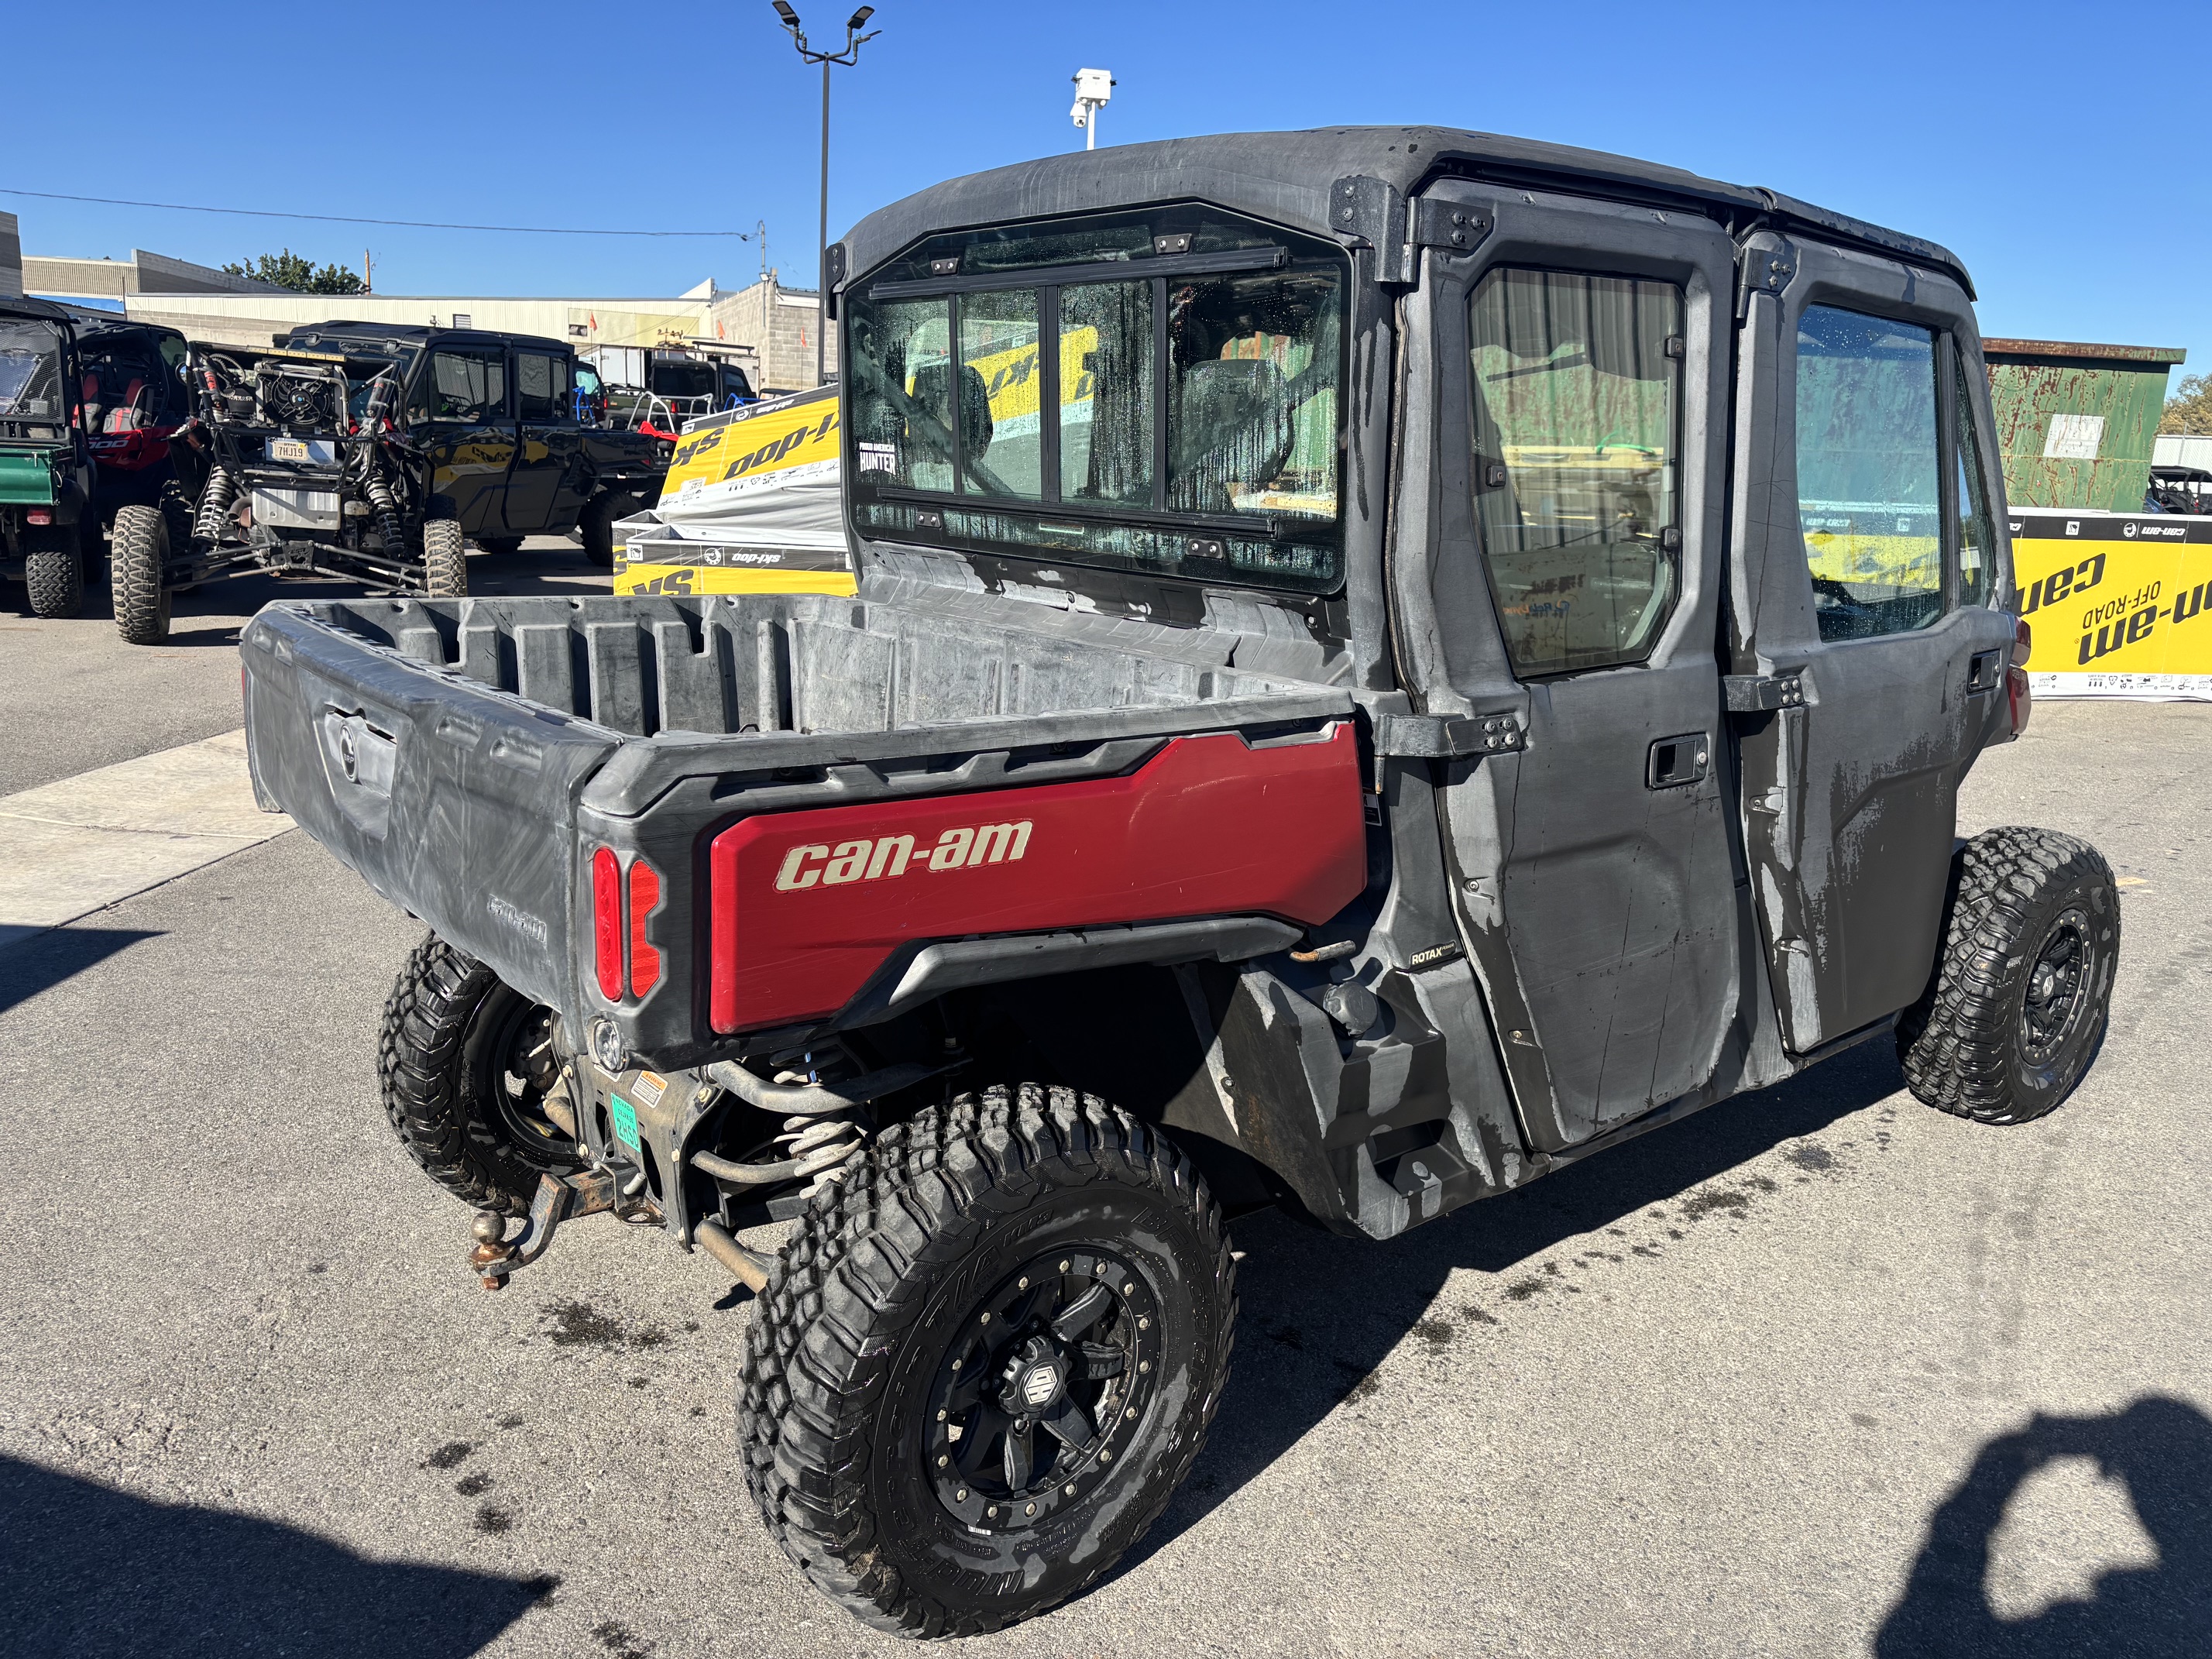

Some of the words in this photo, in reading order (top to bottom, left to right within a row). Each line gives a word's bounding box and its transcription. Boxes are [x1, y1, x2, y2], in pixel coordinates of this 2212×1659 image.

[278, 446, 303, 457] 7HJ19
[723, 410, 840, 480] i-doo
[860, 452, 896, 475] HUNTER
[2141, 526, 2186, 536] can-am
[731, 553, 781, 564] ski-doo
[2082, 581, 2161, 630] OFF-ROAD
[775, 821, 1033, 891] can-am
[1412, 946, 1442, 965] ROTAX
[615, 1098, 634, 1112] NEVADA
[1131, 1207, 1209, 1487] BFGoodrich
